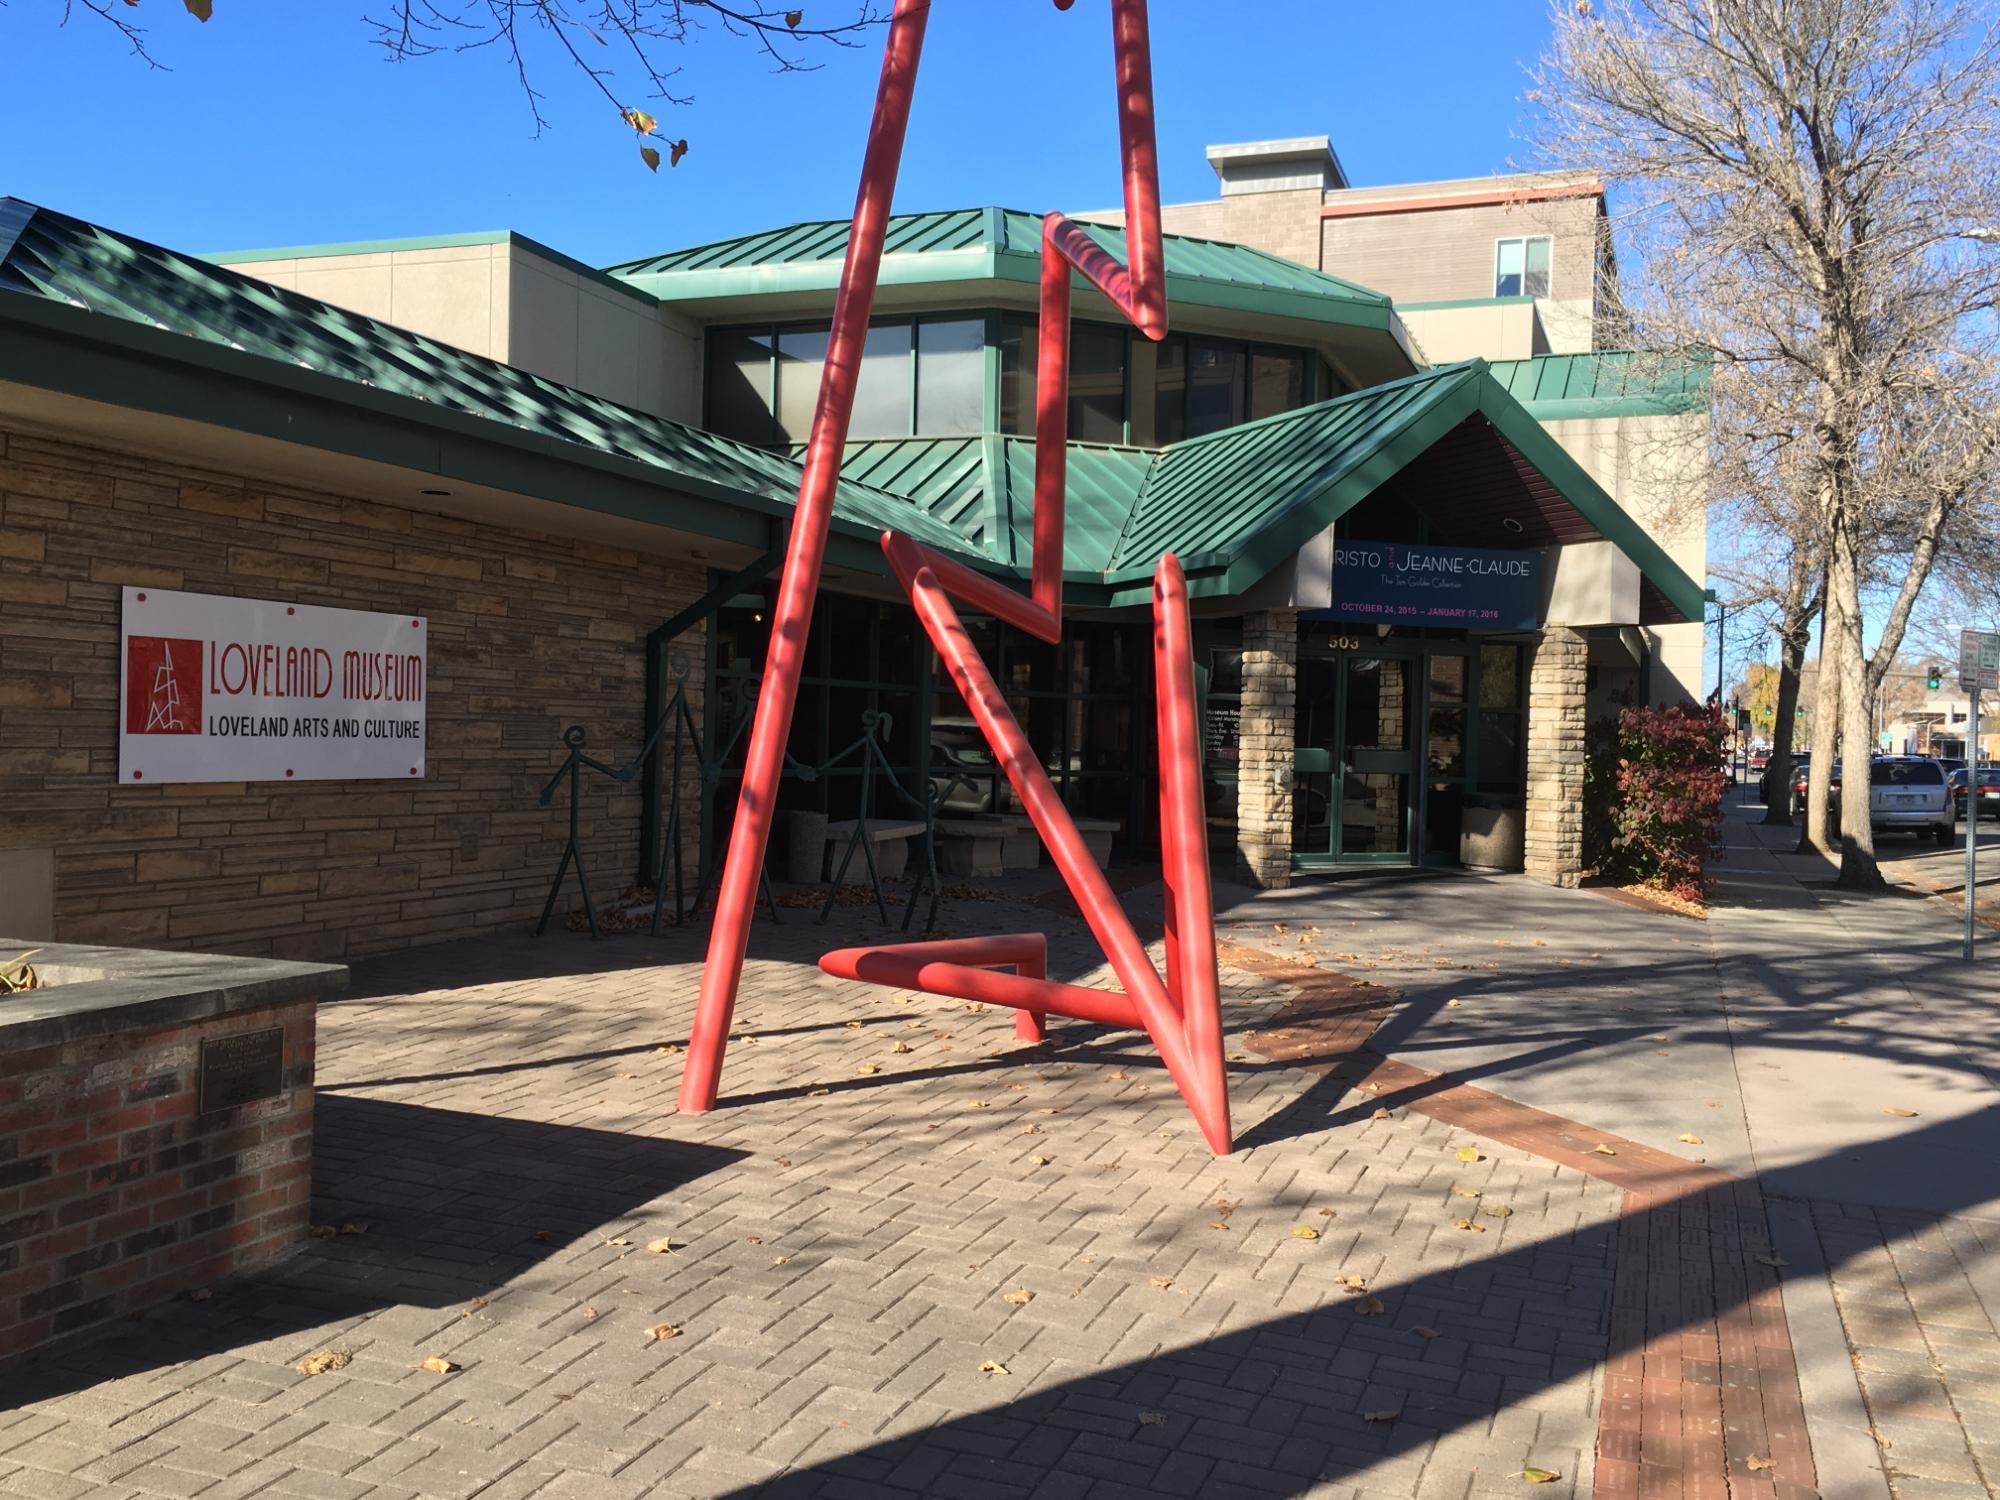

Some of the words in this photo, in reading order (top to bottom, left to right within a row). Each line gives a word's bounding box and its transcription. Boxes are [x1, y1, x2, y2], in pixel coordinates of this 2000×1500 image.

[1341, 602, 1383, 613] OCTOBER
[1398, 606, 1416, 615] 2015
[1427, 607, 1466, 617] JANUARY
[1480, 610, 1499, 618] 2016
[1328, 634, 1360, 650] 503
[210, 640, 333, 699] LOVELAND
[343, 650, 422, 702] MUSEUM
[209, 715, 288, 737] LOVELAND
[293, 717, 329, 738] ARTS
[332, 718, 360, 738] AND
[364, 719, 420, 739] CULTURE
